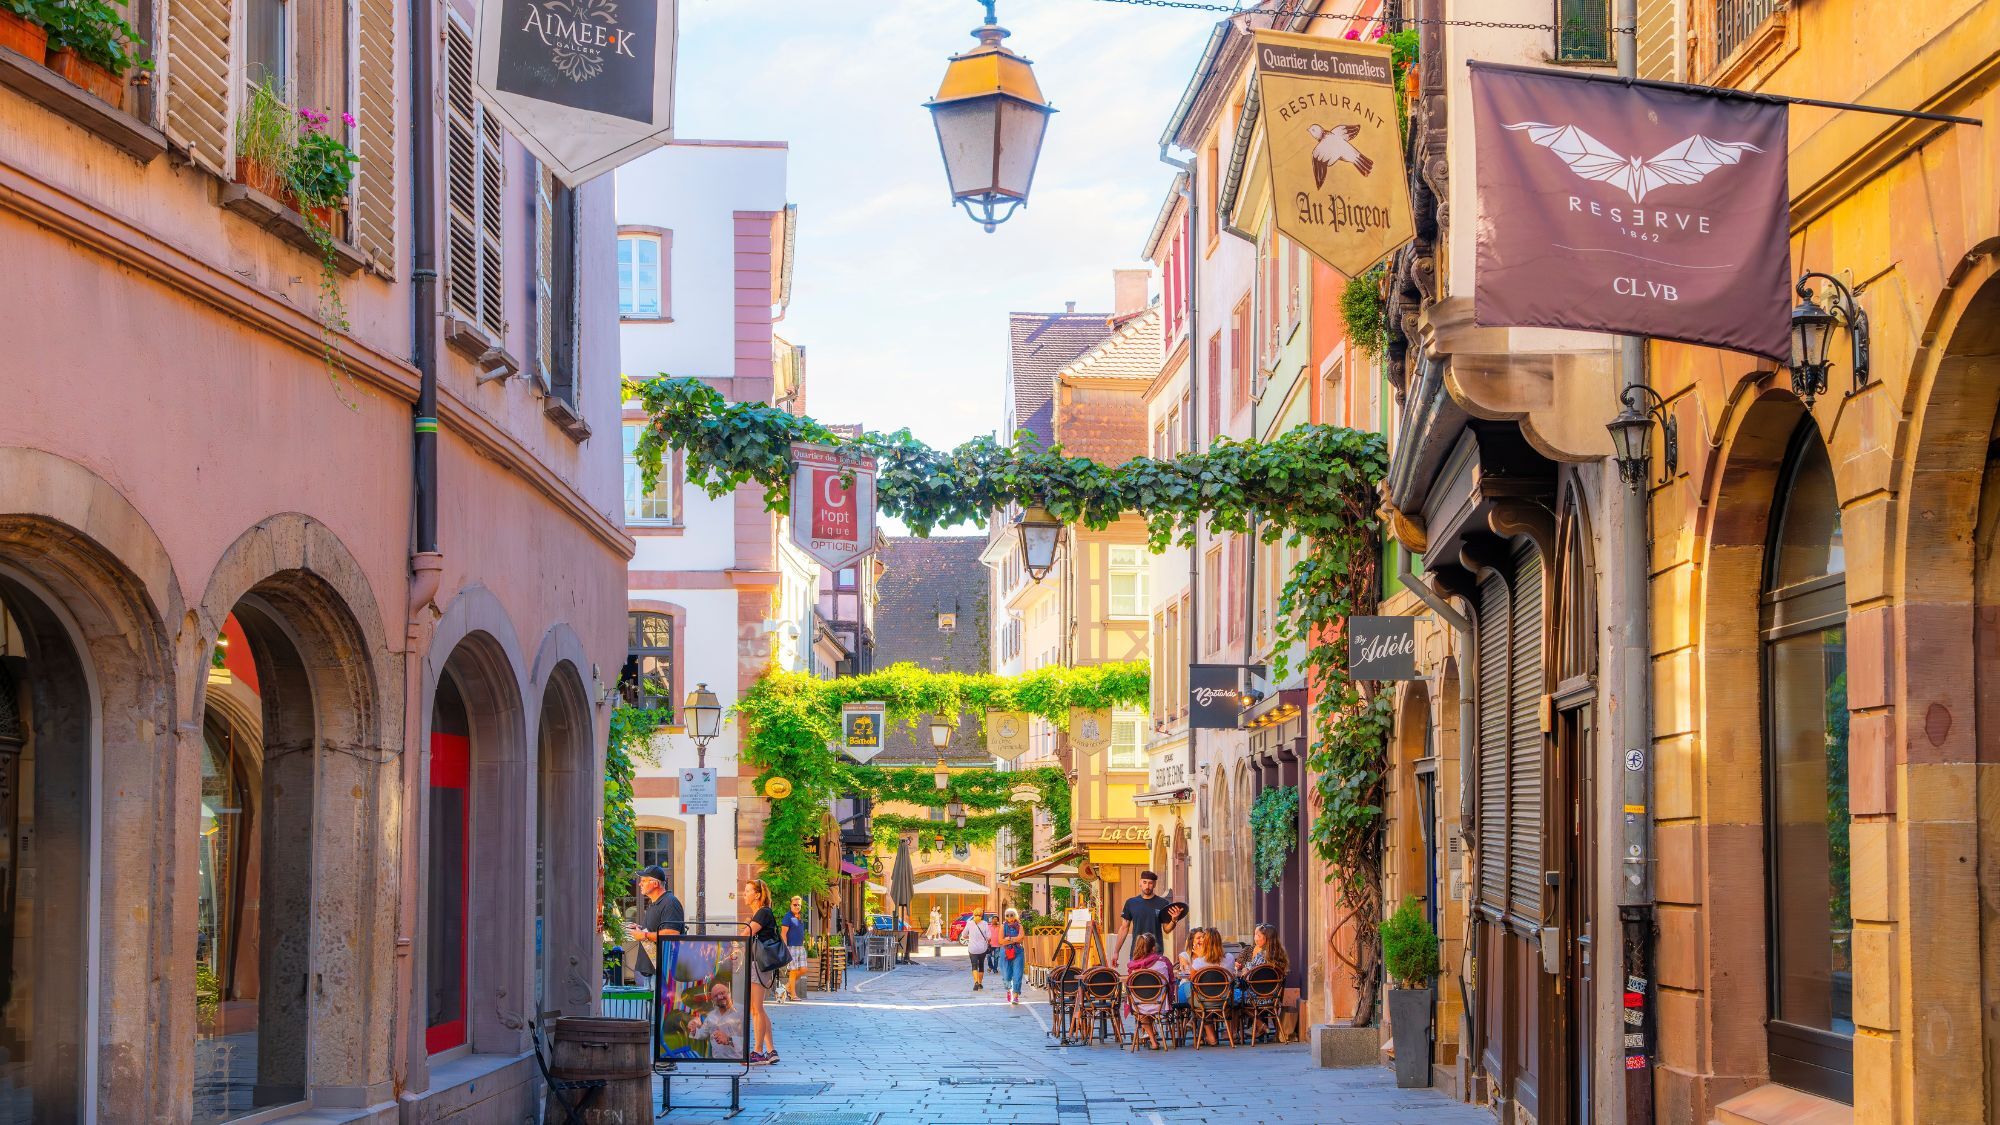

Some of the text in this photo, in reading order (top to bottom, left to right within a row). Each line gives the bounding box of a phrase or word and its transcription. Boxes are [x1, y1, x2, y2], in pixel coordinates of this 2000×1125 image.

[557, 41, 601, 56] GALLERY
[1264, 48, 1386, 79] Quartier des Tonneliers
[1279, 92, 1385, 129] RESTAURANT
[1296, 191, 1391, 233] Au Pigeon
[1620, 227, 1660, 244] 1862
[1613, 276, 1679, 302] CLVB
[793, 449, 823, 461] Quartier
[825, 453, 837, 463] des
[824, 475, 847, 508] C
[811, 540, 858, 553] OPTICIEN
[1099, 825, 1121, 841] La
